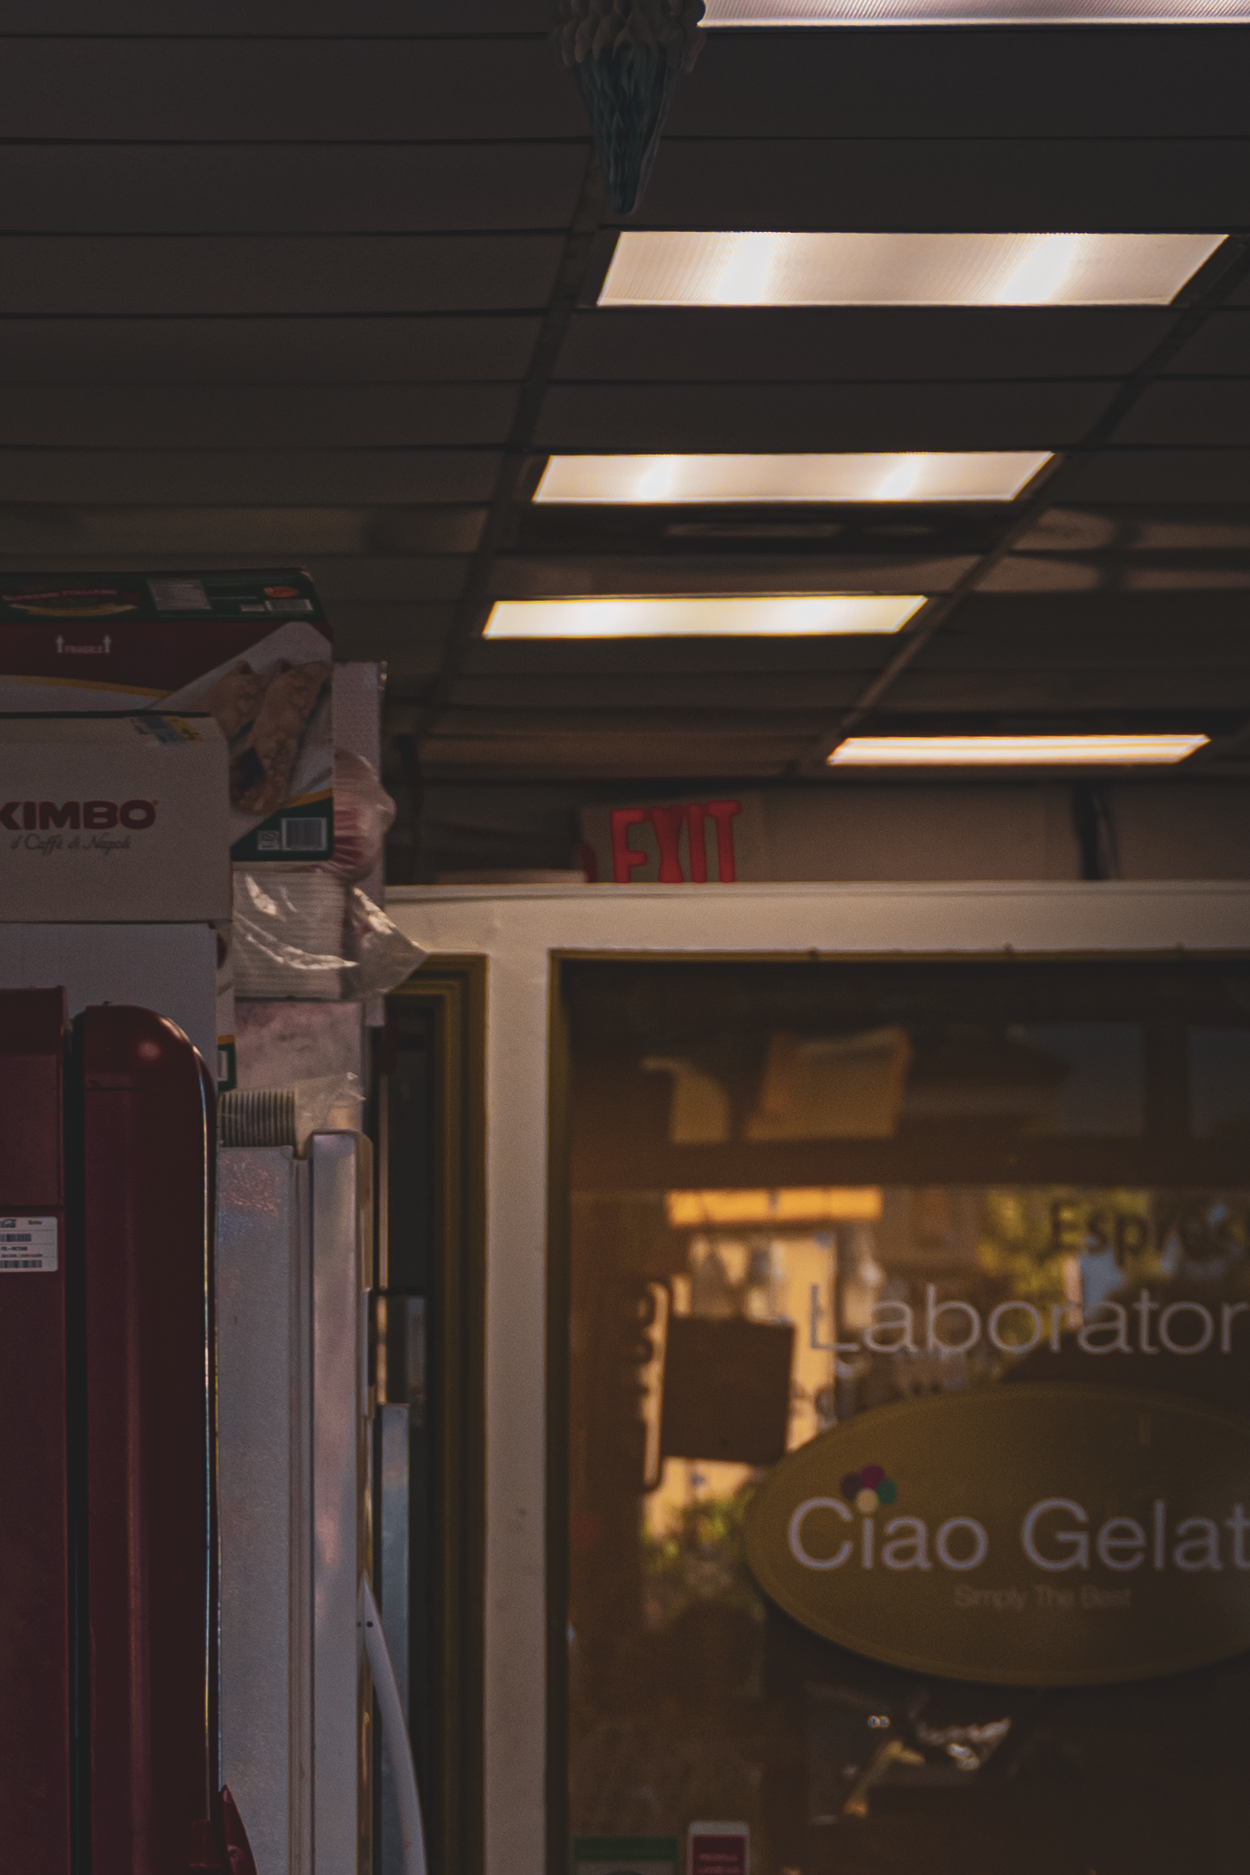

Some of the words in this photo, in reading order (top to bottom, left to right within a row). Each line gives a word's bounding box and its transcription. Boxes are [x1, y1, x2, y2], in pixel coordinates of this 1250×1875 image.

[83, 834, 131, 856] Napoli
[610, 799, 742, 884] EXIT
[810, 1283, 1250, 1354] Laborator
[787, 1496, 990, 1571] Ciao
[1020, 1496, 1250, 1571] Gelat
[953, 1584, 1027, 1612] Simply
[1035, 1584, 1075, 1608] The
[1081, 1584, 1132, 1608] Best
